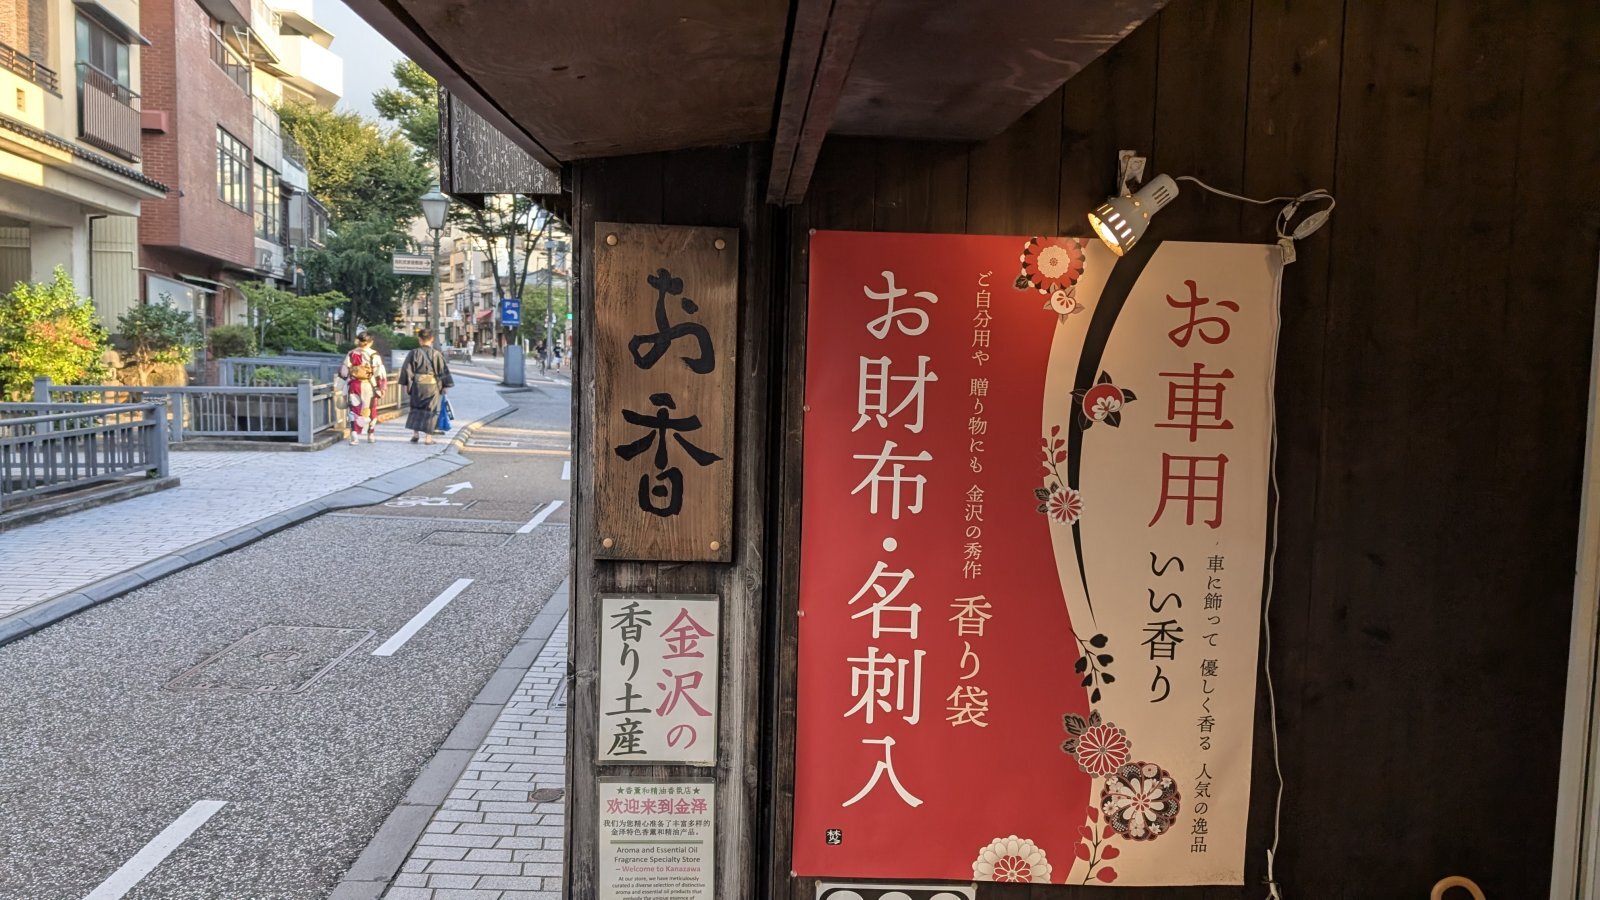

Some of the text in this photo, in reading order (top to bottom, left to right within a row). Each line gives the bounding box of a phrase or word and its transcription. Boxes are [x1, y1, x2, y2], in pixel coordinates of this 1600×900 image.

[614, 268, 723, 517] お香
[1148, 279, 1240, 529] お車用
[841, 270, 939, 808] お財布・名刺入
[945, 271, 993, 728] ご自分用や 贈り物にも 金沢の秀作 香り袋
[604, 601, 652, 756] 香り土産
[655, 607, 715, 750] 金沢の
[1141, 551, 1185, 703] いい香り
[1190, 554, 1225, 853] 車に飾って 優しく香る 人気の逸品
[606, 798, 707, 815] 欢迎来到金泽
[614, 856, 649, 865] Fragrance
[649, 856, 681, 865] Specialty
[670, 888, 691, 896] products
